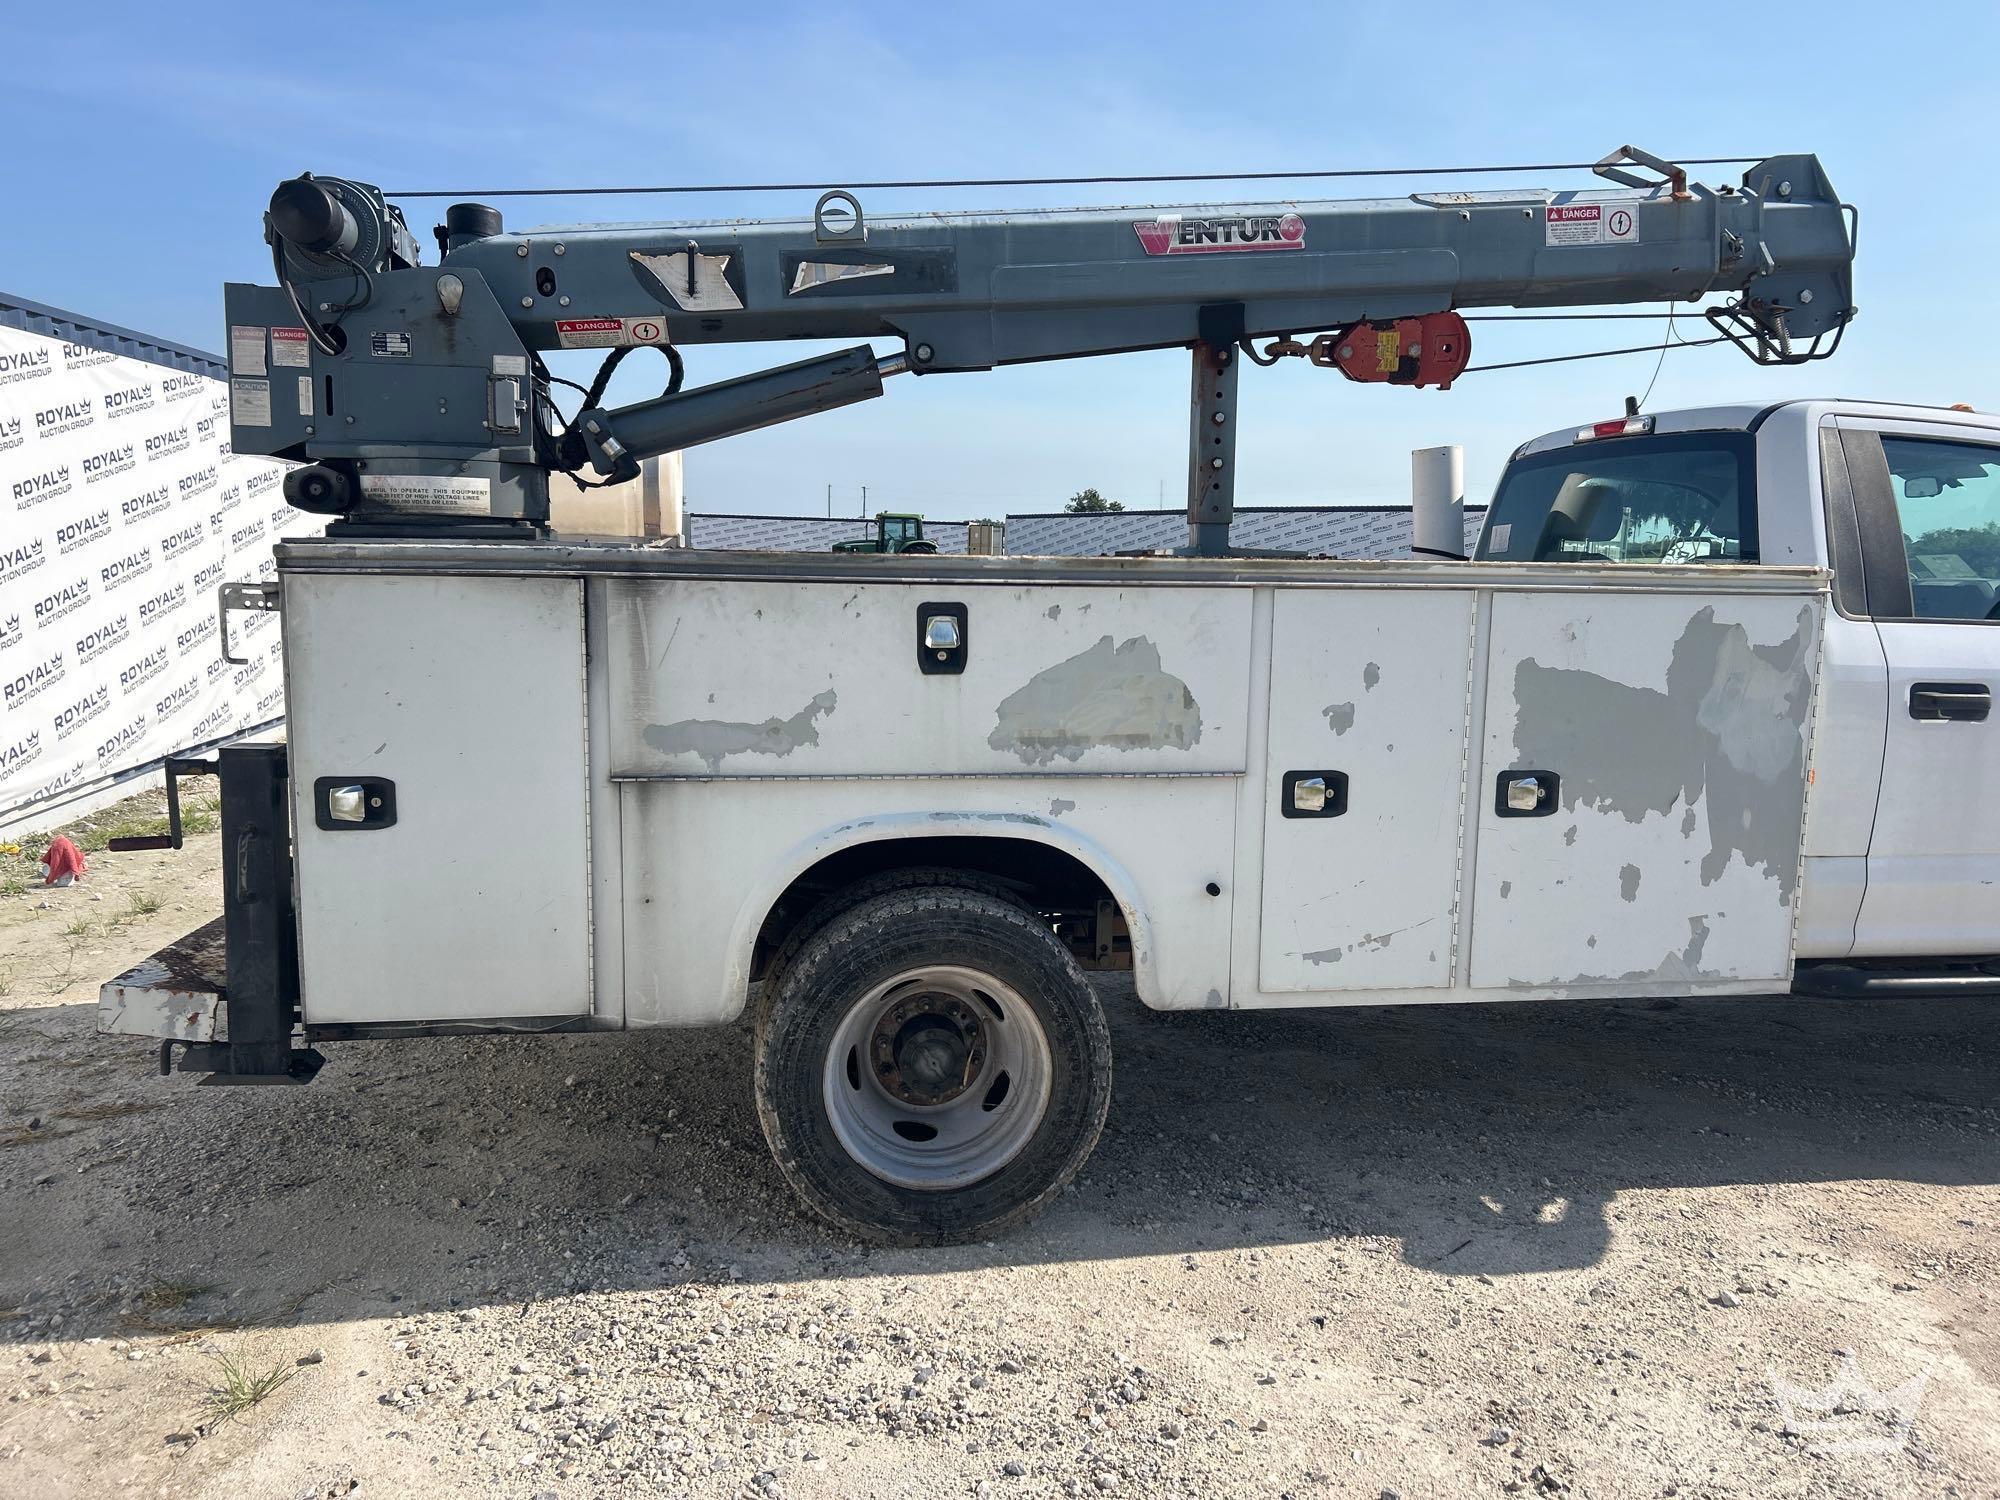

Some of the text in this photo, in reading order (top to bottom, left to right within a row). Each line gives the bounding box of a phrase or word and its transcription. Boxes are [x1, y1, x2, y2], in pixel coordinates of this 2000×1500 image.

[1563, 210, 1598, 218] DANGER
[0, 351, 38, 372] OYAL
[66, 355, 118, 370] AUCTION GROUP
[0, 367, 52, 386] UCTION GROUP
[163, 374, 195, 392] ROYAL
[104, 388, 143, 408] ROYAL
[166, 386, 204, 402] AUCTION GROUP
[36, 404, 80, 428] ROYAL
[108, 401, 154, 420] AUCTION GROUP
[40, 418, 94, 439] AUCTION GROUP
[197, 417, 214, 434] ROY
[200, 432, 215, 442] AUCTIO
[145, 430, 180, 452] ROYAL
[148, 441, 190, 462] AUCTION GROUP
[83, 449, 124, 473] ROYAL
[86, 460, 136, 484] AUCTION GROUP
[13, 472, 58, 499] ROYAL
[179, 470, 209, 492] ROYAL
[247, 471, 273, 491] ROYAL
[17, 484, 72, 511] AUCTION GROUP
[122, 491, 160, 515] ROYAL
[125, 501, 171, 526] AUCTION GROUP
[57, 516, 99, 544] ROYAL
[60, 526, 112, 555] AUCTION GROUP
[162, 528, 195, 552] ROYAL
[232, 524, 257, 545] ROYAL
[22, 556, 45, 574] GROUP
[102, 554, 140, 582] ROYAL
[194, 561, 222, 586] ROYAL
[259, 557, 276, 574] ROY
[105, 563, 152, 592] AUCTION GROUP
[35, 586, 78, 618] ROYAL
[38, 594, 91, 629] AUCTION GROUP
[139, 590, 176, 618] ROYAL
[0, 633, 22, 650] ROUP
[77, 623, 117, 655] ROYAL
[177, 620, 208, 648] ROYAL
[80, 631, 129, 666] AUCTION GROUP
[4, 662, 52, 700] ROYAL
[120, 654, 157, 686] ROYAL
[124, 661, 169, 695] AUCTION GROUP
[8, 670, 65, 712] AUCTION GROUP
[156, 684, 190, 715] ROYAL
[54, 694, 98, 730] ROYAL
[58, 700, 110, 741] AUCTION GROUP
[193, 708, 222, 739] ROYAL
[0, 742, 27, 767] YAL
[97, 725, 136, 760] ROYAL
[100, 730, 146, 770] AUCTION GROUP
[16, 747, 42, 771] GROUP
